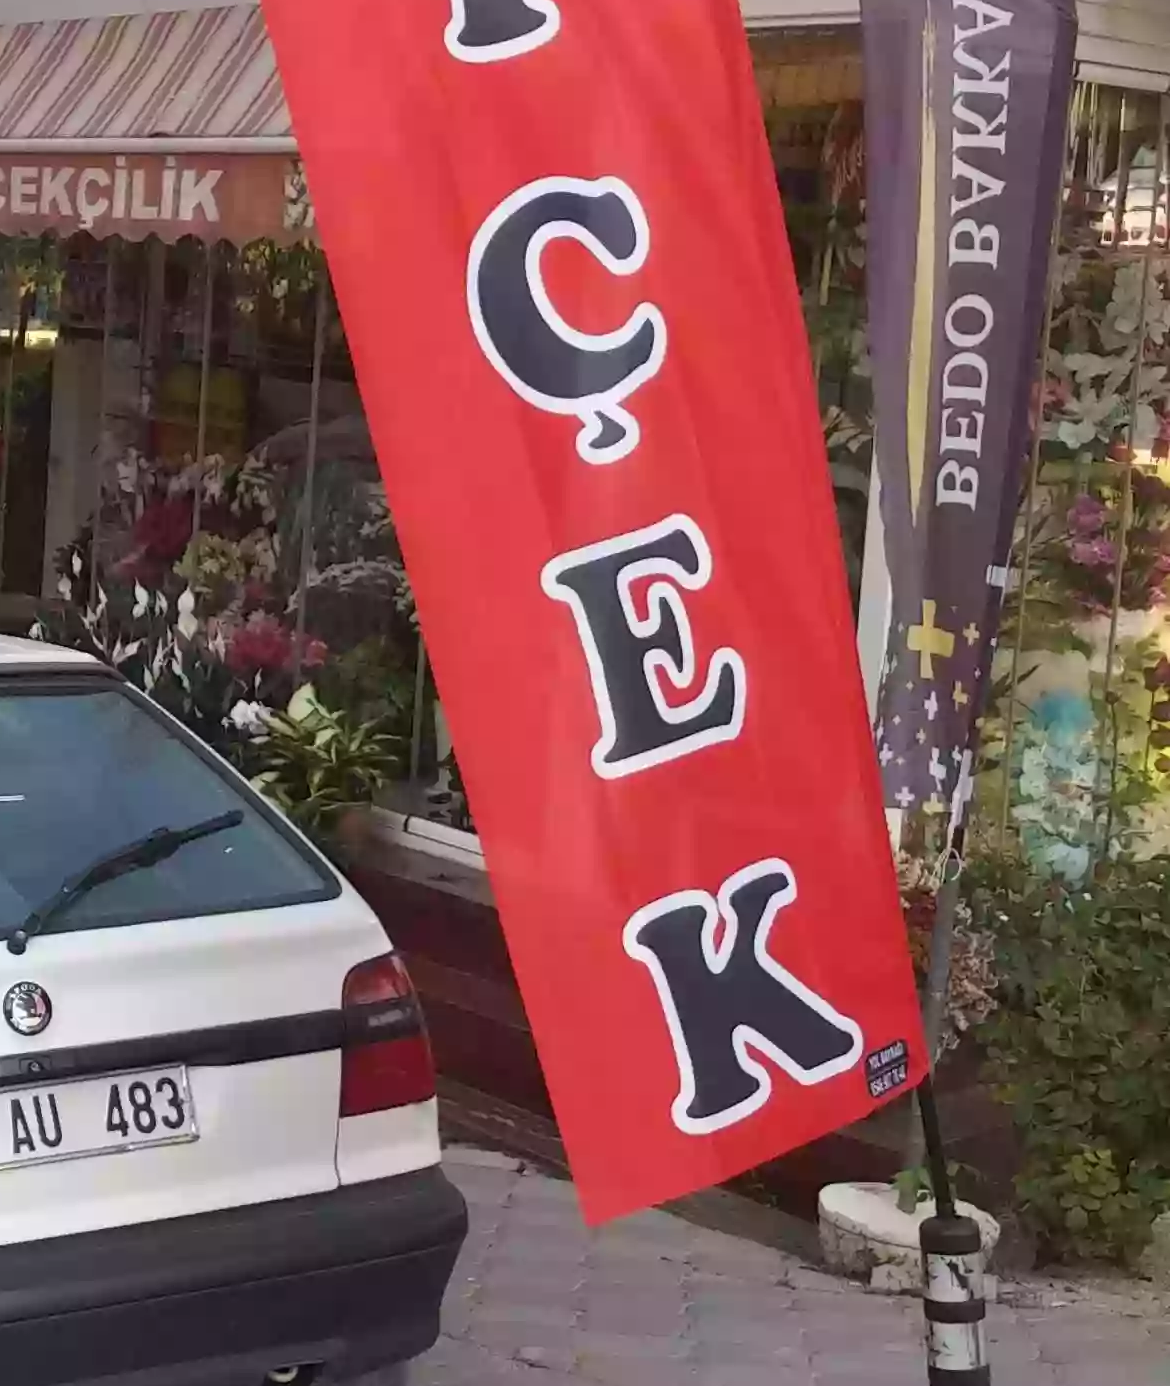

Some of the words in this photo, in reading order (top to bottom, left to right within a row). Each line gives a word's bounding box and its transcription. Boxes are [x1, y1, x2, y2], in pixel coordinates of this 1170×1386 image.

[935, 293, 995, 513] BEDO
[9, 1093, 63, 1154] AU
[106, 1076, 185, 1138] 483
